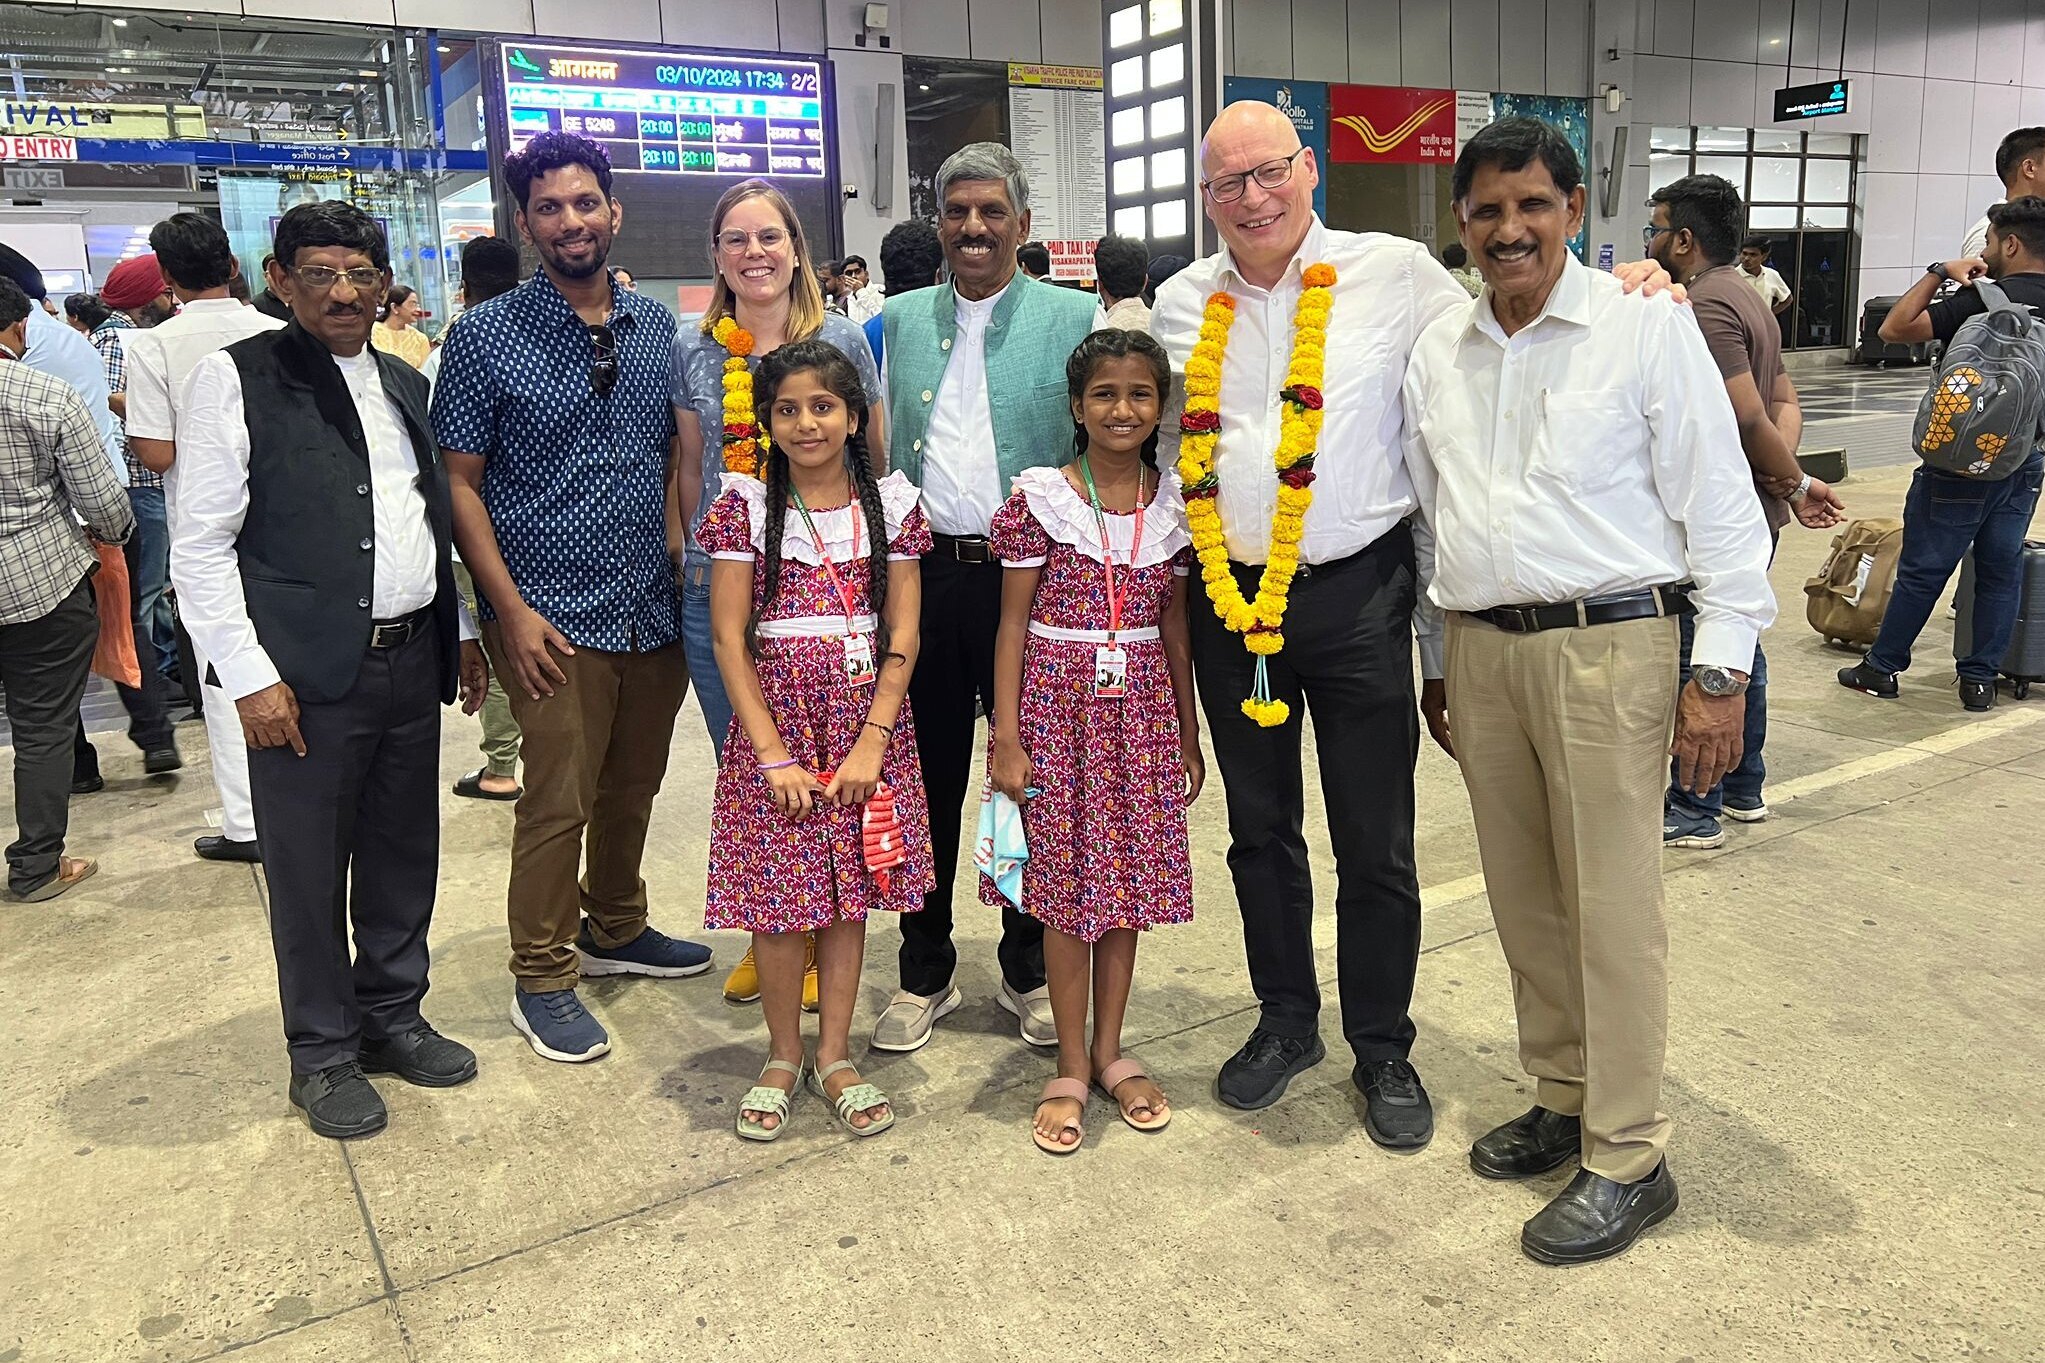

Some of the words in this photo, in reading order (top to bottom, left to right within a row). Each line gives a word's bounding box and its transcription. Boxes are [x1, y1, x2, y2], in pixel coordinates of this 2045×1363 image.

[548, 58, 618, 80] आगमन
[656, 65, 742, 86] 03/10/2024
[745, 70, 785, 89] 17:34
[791, 73, 816, 91] 2/2
[640, 120, 673, 134] 20:00
[680, 122, 712, 136] 20:00
[14, 138, 72, 158] ENTRY
[1420, 146, 1435, 156] India
[1440, 147, 1451, 156] Post
[643, 150, 676, 164] 20:10
[682, 151, 713, 166] 20:10
[1066, 241, 1083, 255] TAXI
